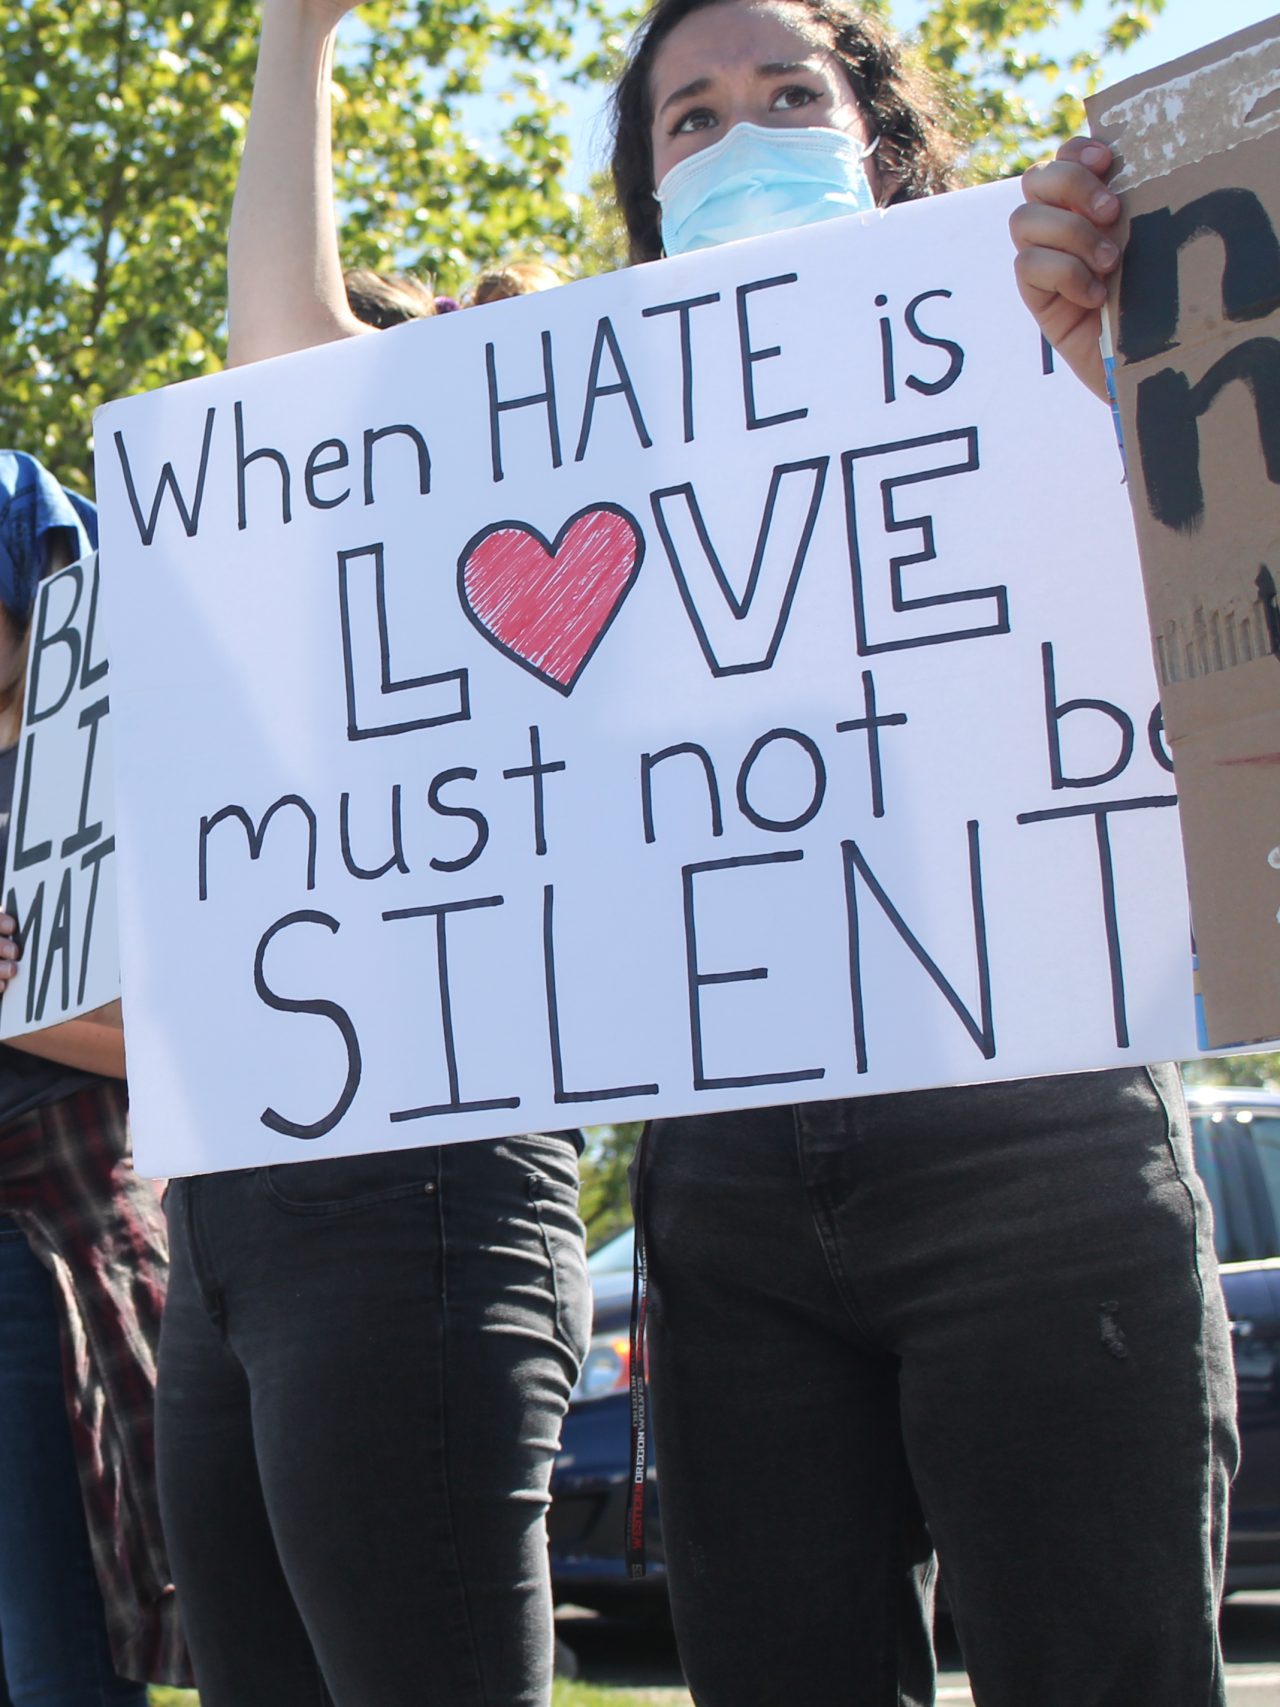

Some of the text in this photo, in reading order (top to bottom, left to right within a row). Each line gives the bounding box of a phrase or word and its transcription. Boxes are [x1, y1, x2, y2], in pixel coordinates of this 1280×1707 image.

[114, 273, 965, 546] When HATE is
[199, 726, 565, 900] must
[641, 670, 908, 843] not
[254, 795, 1178, 1140] SILENT
[634, 1431, 645, 1485] OREGON
